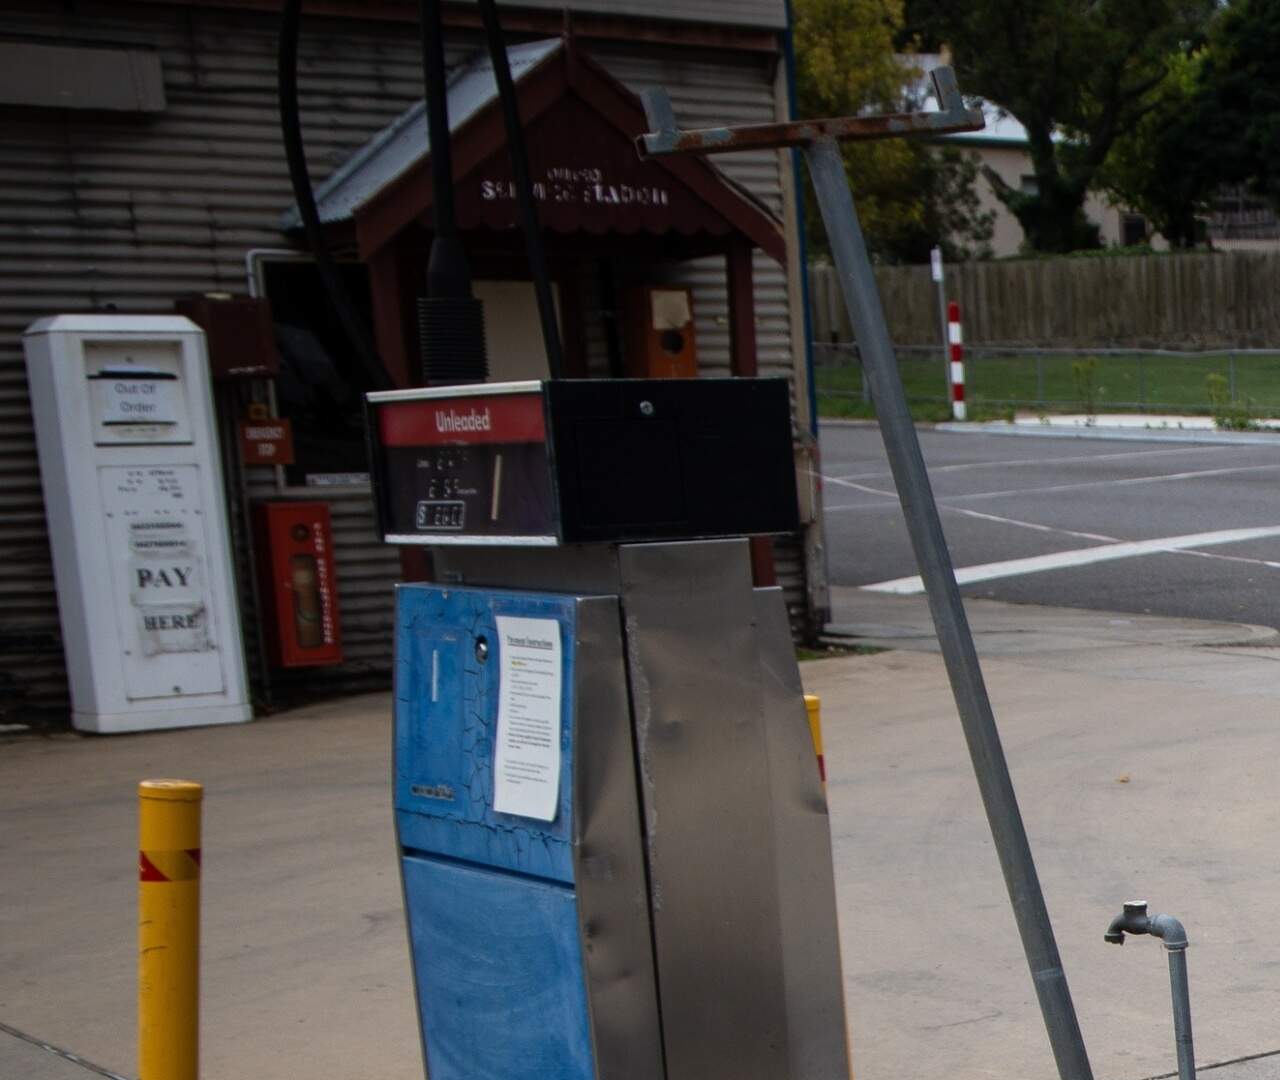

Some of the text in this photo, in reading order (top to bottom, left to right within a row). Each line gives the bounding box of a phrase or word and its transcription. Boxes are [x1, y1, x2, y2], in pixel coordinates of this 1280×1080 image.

[436, 408, 491, 432] Unleaded
[137, 567, 192, 588] PAY
[144, 614, 200, 632] HERE
